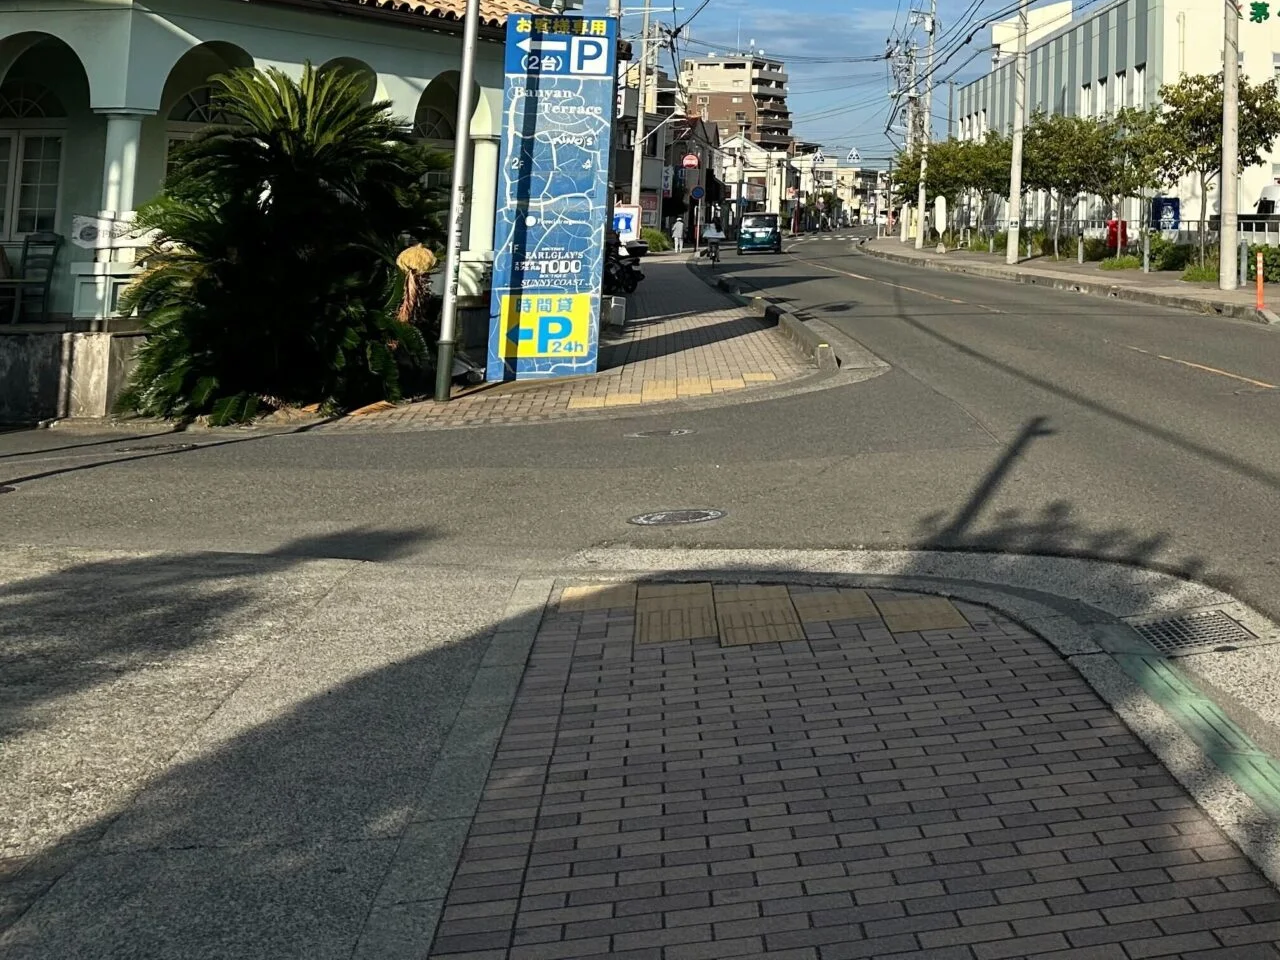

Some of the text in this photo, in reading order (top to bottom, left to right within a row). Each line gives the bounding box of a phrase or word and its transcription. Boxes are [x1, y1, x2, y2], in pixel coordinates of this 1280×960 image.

[577, 40, 603, 71] P
[513, 86, 572, 100] Banyan
[540, 102, 602, 115] Terrace
[511, 157, 524, 170] 2F
[525, 251, 584, 261] EARLGLAY'S
[539, 259, 582, 274] TODO
[520, 278, 585, 287] SUNNY COAST
[516, 297, 573, 313] 時間貸
[537, 316, 573, 354] P
[552, 340, 584, 353] 24h
